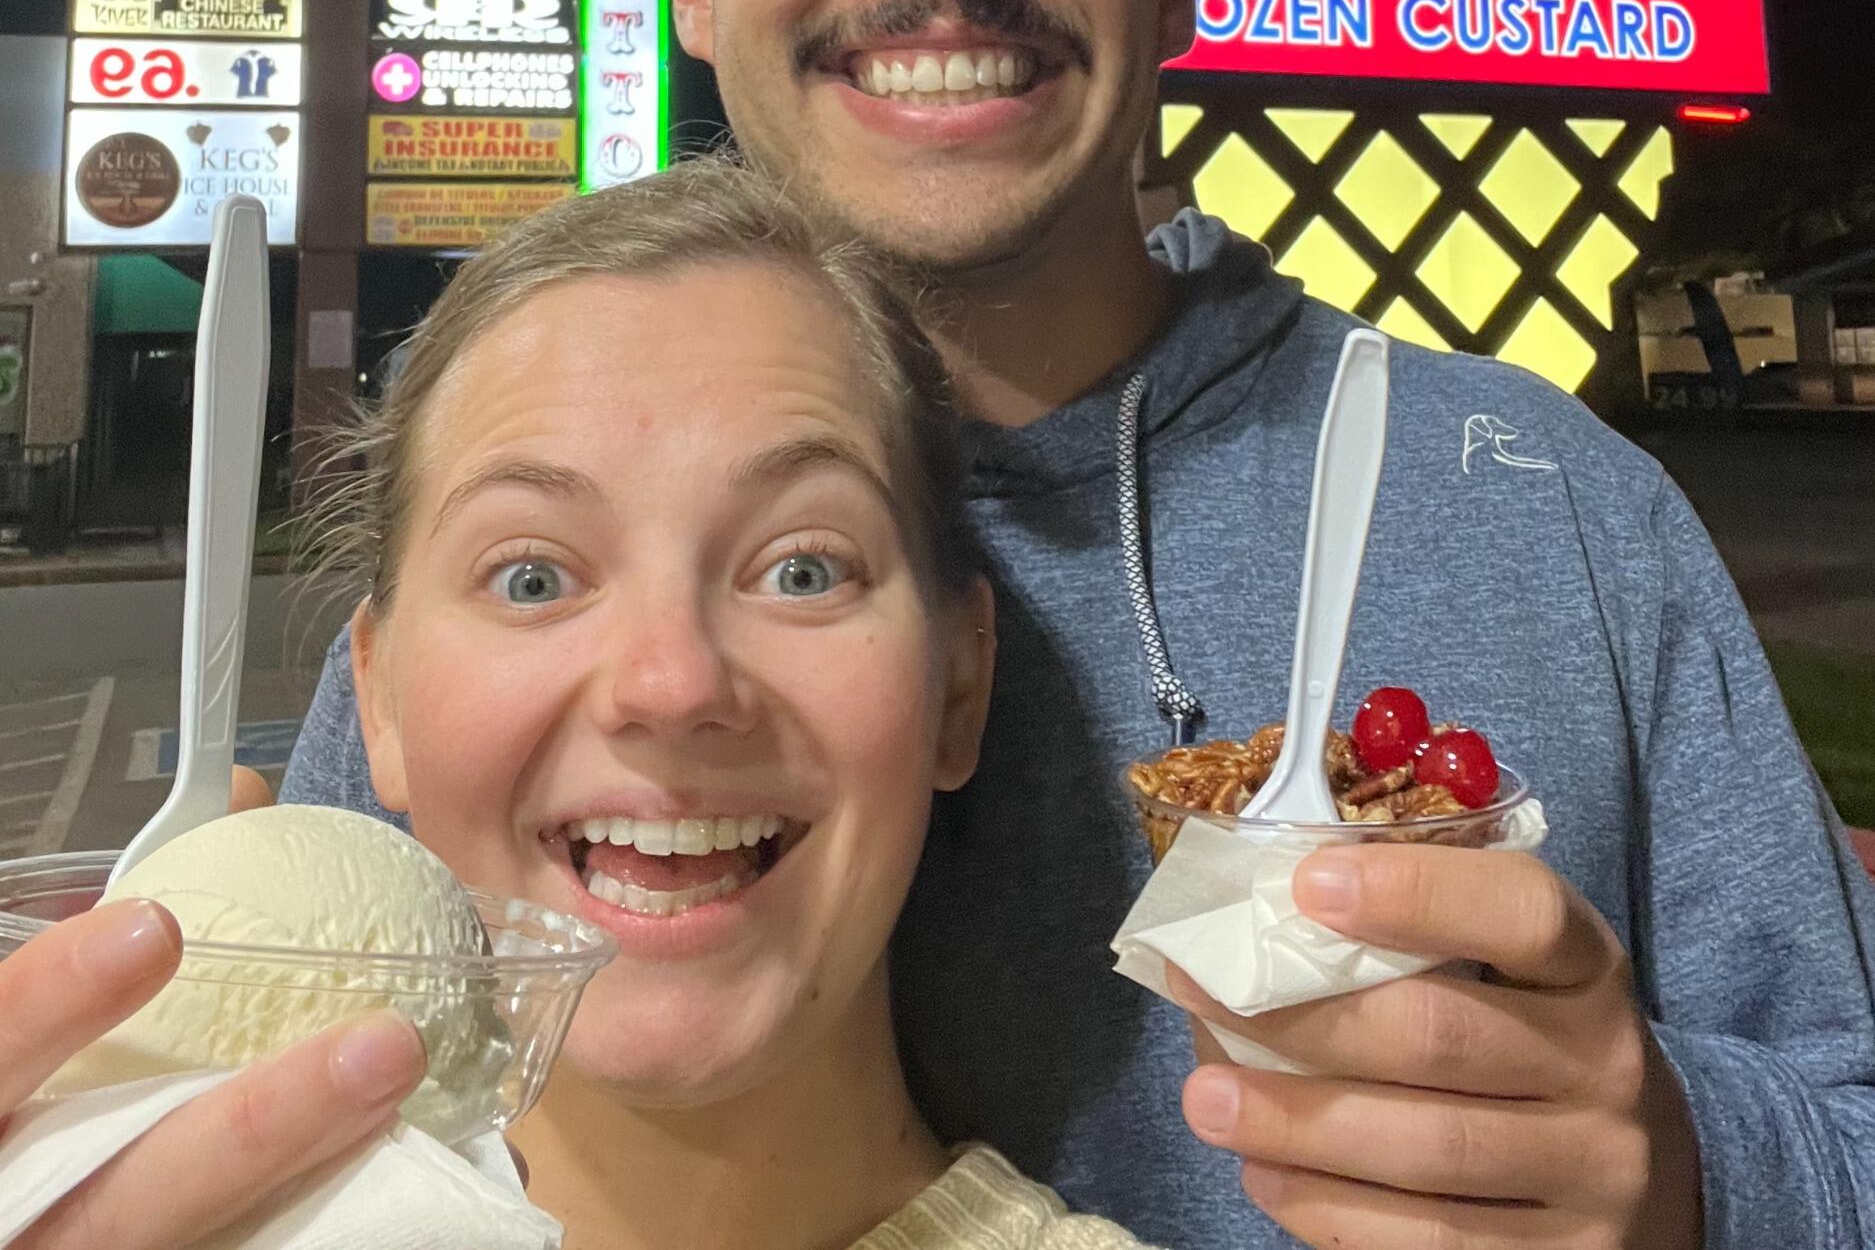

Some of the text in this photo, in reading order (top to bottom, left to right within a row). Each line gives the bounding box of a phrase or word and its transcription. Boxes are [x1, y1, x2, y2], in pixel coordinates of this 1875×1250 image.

[161, 10, 284, 32] RESTAURANT
[378, 22, 571, 44] WIRELESS
[422, 50, 575, 74] CELLPHONES
[422, 70, 568, 90] UNLOCKING
[453, 88, 573, 109] REPAIRS
[421, 120, 525, 138] SUPER
[200, 147, 280, 173] KEG'S
[383, 140, 557, 159] INSURANCE
